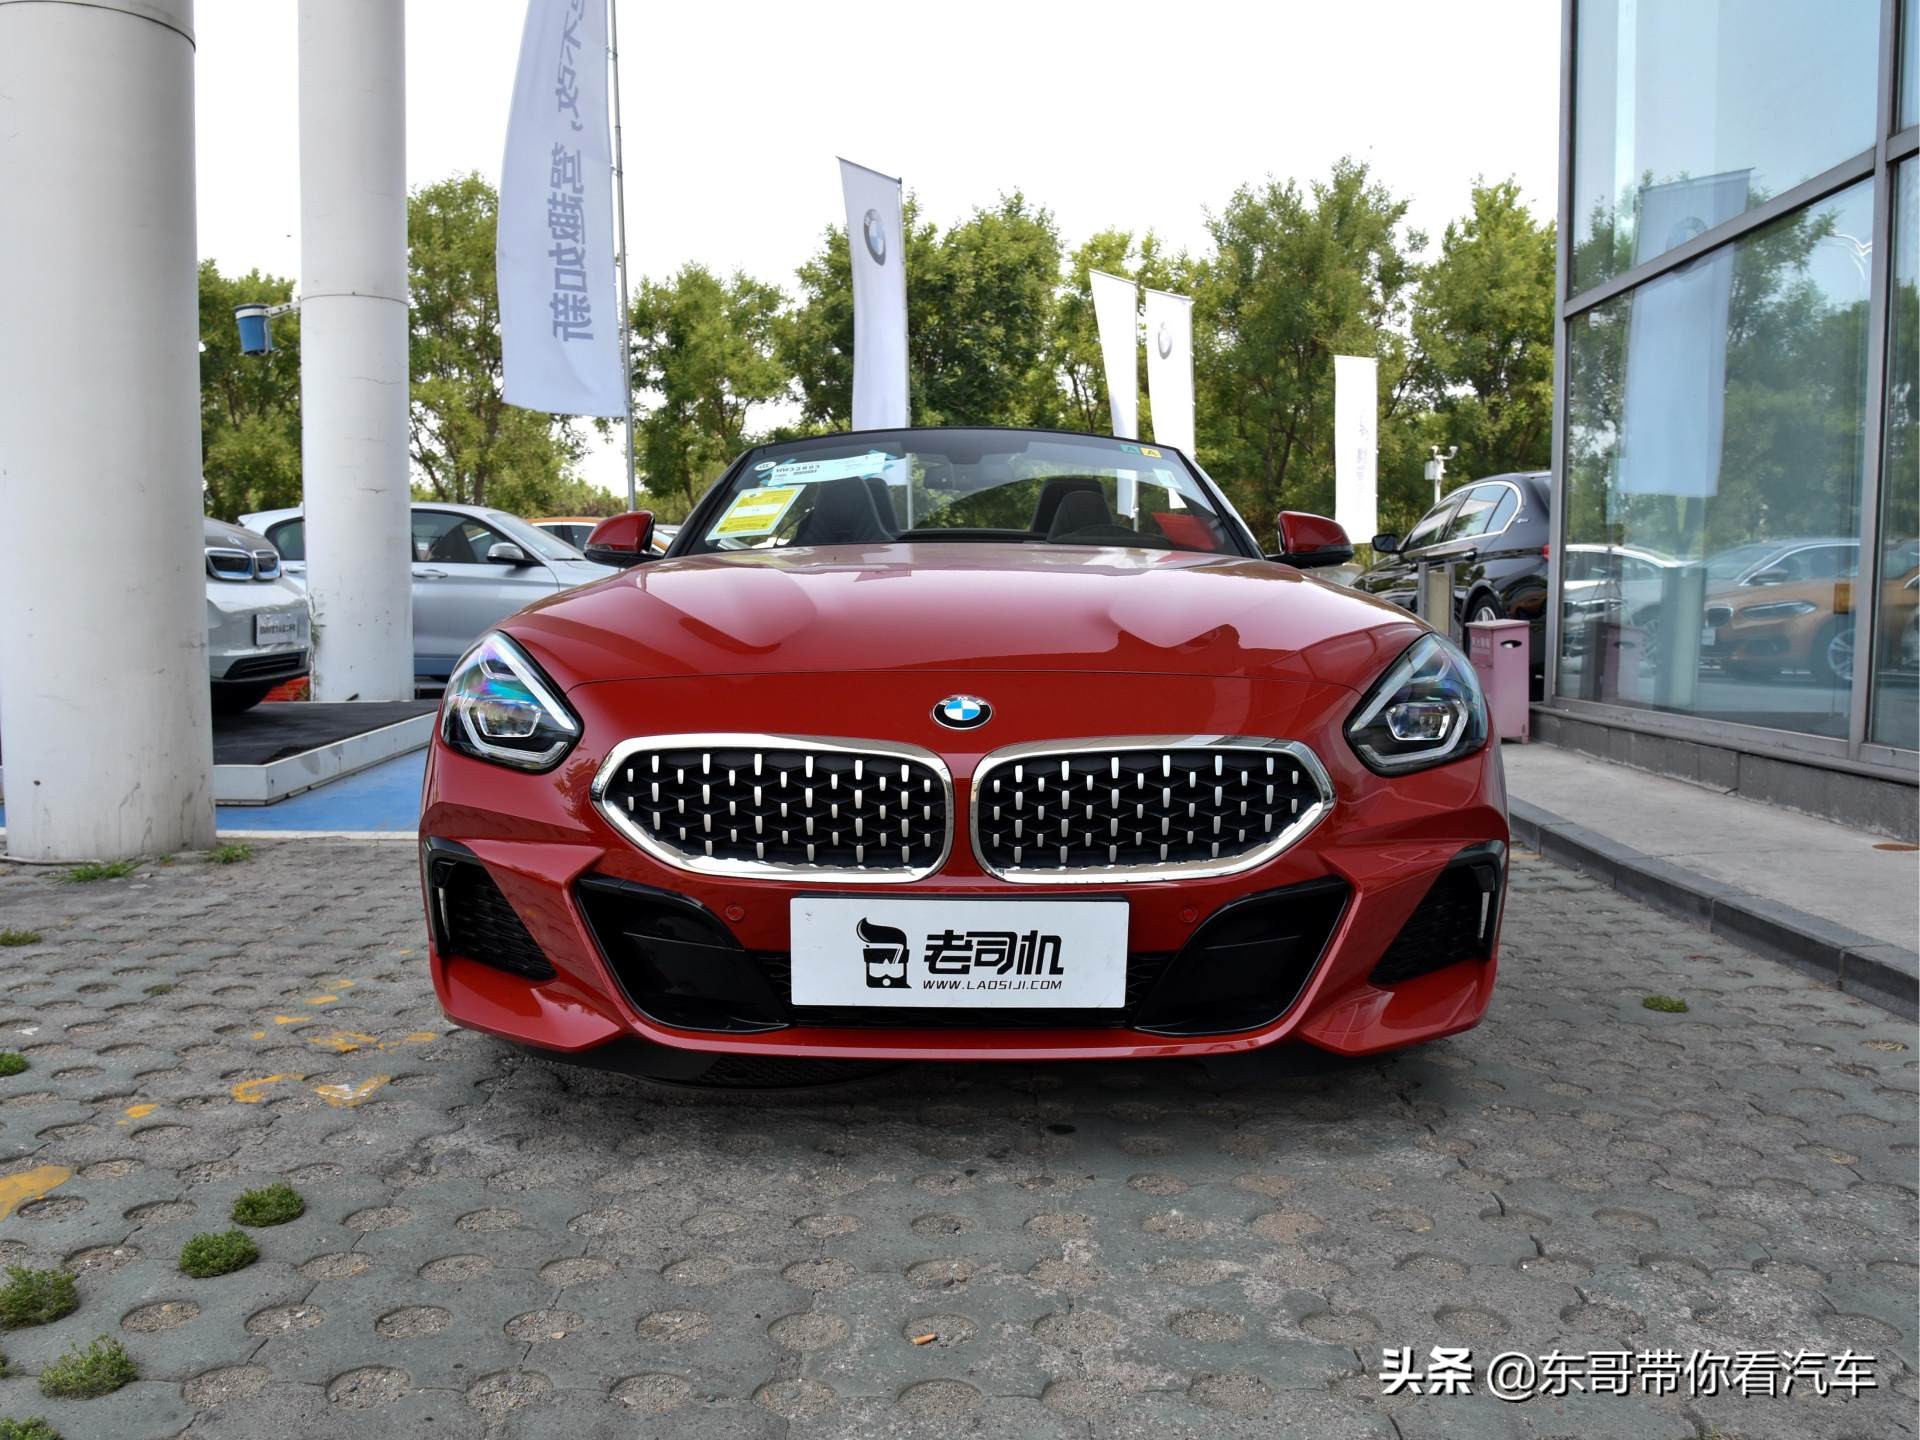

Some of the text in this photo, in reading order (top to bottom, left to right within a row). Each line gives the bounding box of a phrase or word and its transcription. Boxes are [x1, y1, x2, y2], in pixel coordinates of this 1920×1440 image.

[923, 930, 1064, 976] 老司机
[923, 980, 1062, 990] WWW.LAOSIJI.COM
